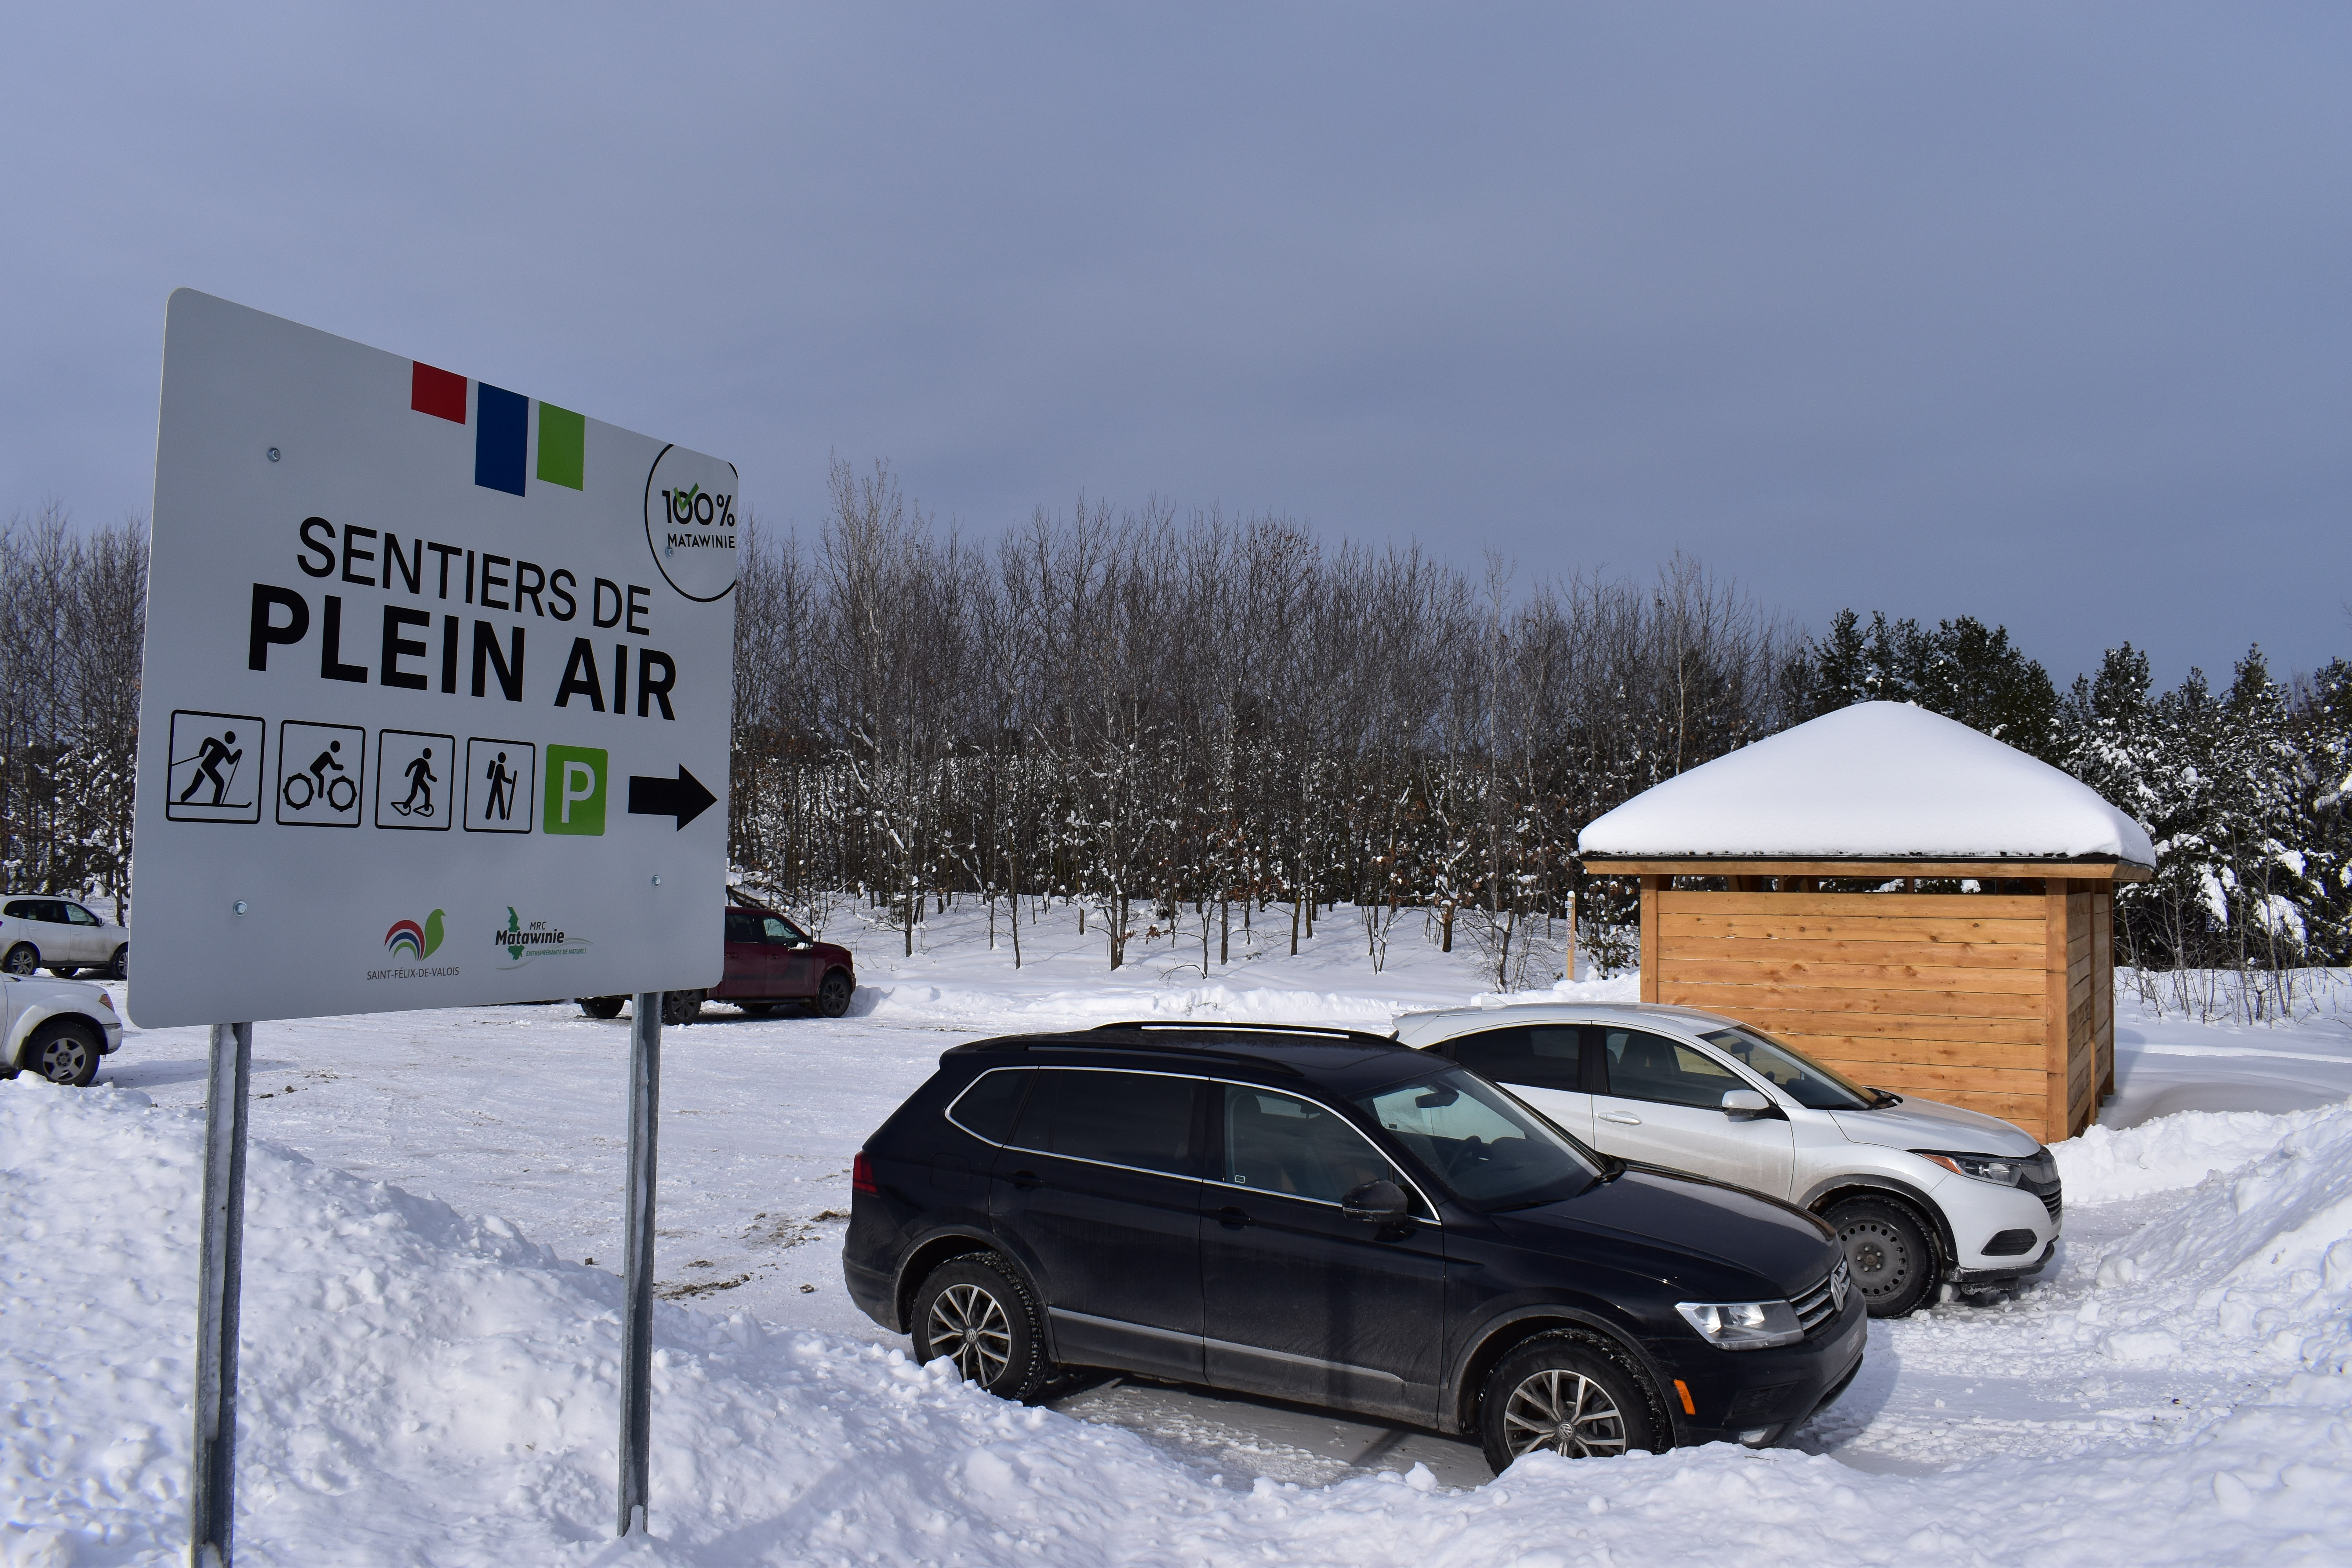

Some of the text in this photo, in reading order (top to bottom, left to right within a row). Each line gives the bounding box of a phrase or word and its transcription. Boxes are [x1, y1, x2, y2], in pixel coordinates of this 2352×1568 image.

[662, 490, 735, 527] 100%
[668, 533, 735, 549] MATAWINIE
[297, 517, 650, 636] SENTIERS DE
[248, 583, 676, 721] PLEIN AIR
[561, 760, 596, 823] P
[495, 929, 564, 946] Matawinie
[530, 921, 546, 930] MRC
[367, 967, 459, 980] SAINT-FÉLIX-DE-VALOIS
